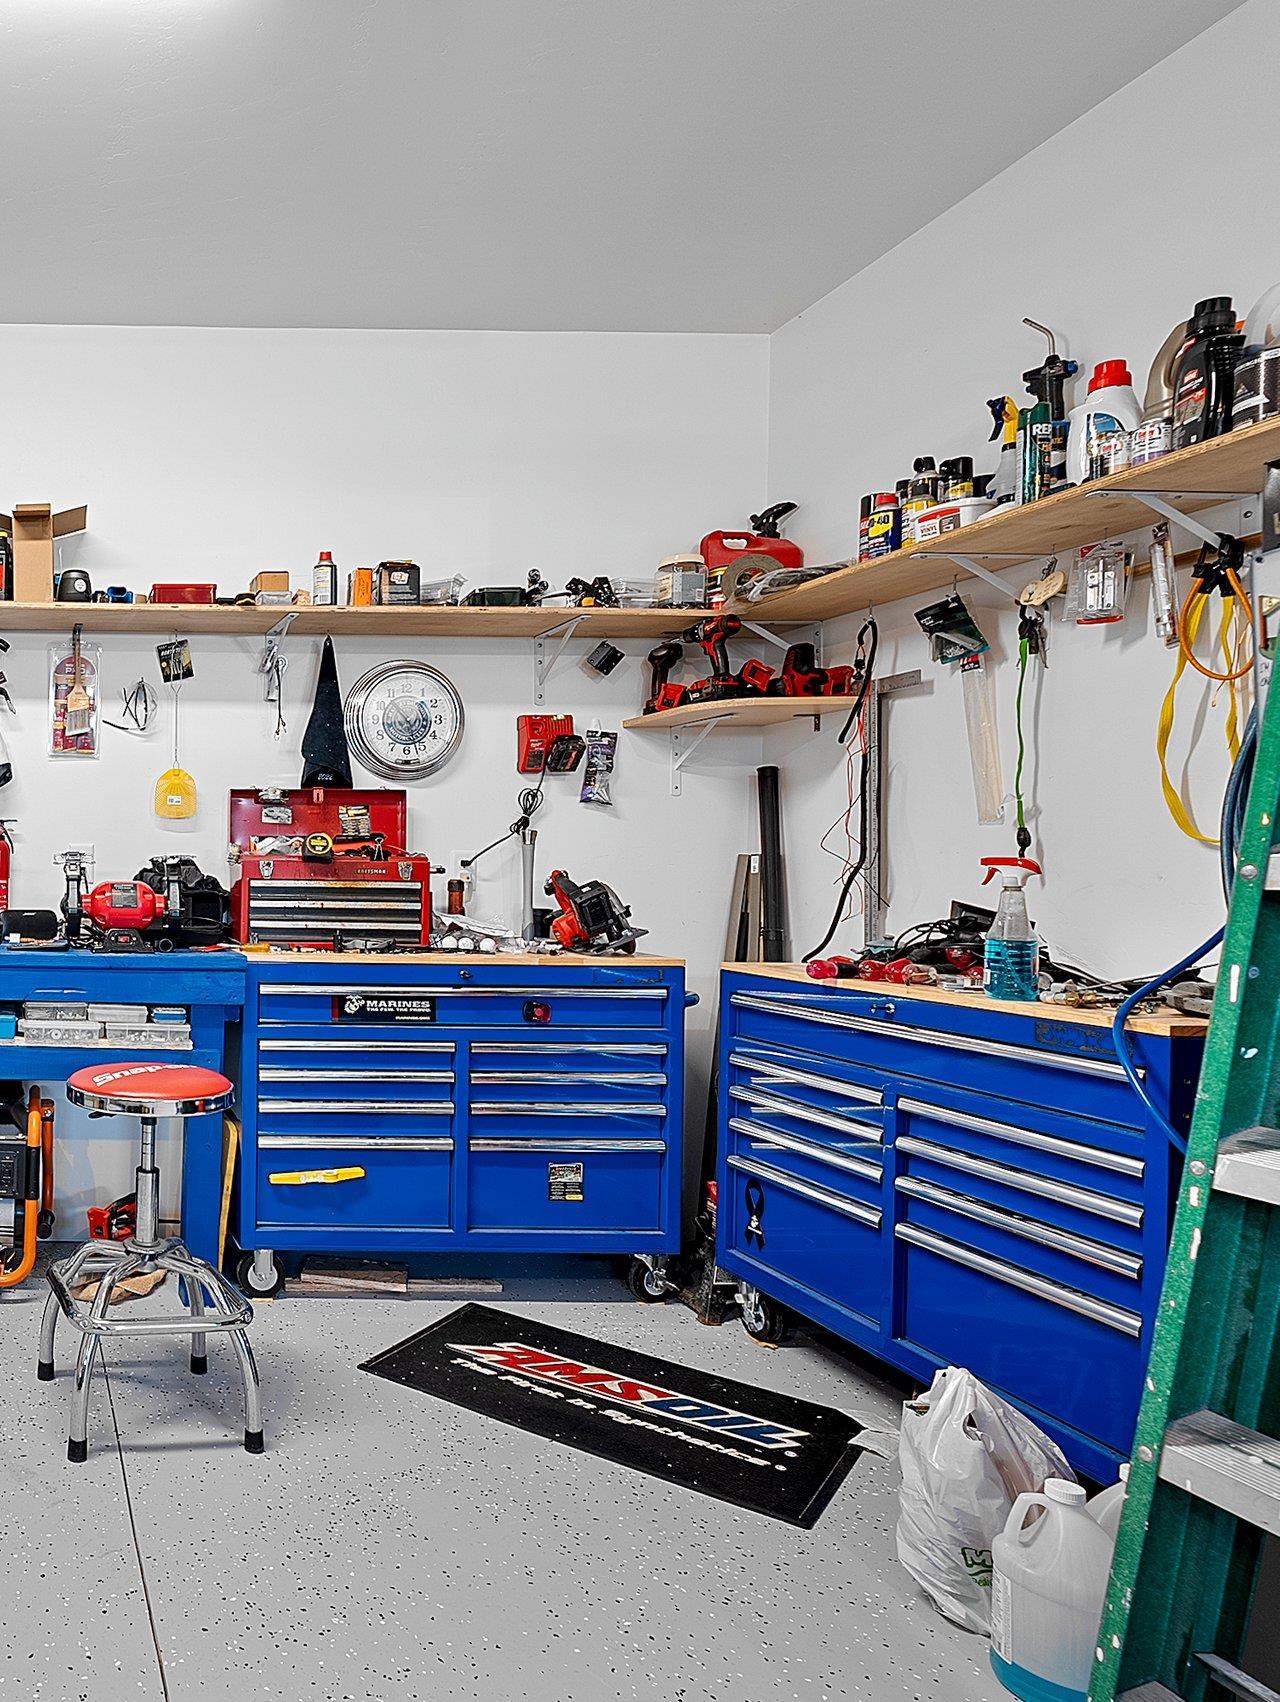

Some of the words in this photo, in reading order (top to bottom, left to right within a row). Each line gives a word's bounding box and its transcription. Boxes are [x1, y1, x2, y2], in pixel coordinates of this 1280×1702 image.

[387, 688, 396, 698] 11
[401, 683, 413, 694] 12
[420, 687, 426, 697] 1
[376, 700, 386, 712] 10
[430, 698, 439, 709] 2
[371, 713, 380, 725] 9
[434, 713, 443, 726] 3
[376, 729, 385, 741] 8
[429, 729, 438, 740] 4
[388, 741, 397, 752] 7
[402, 745, 411, 756] 6
[418, 741, 427, 752] 5
[366, 1000, 431, 1008] MARINES
[450, 1357, 497, 1376] The
[498, 1374, 565, 1400] First
[565, 1397, 597, 1411] in
[445, 1342, 811, 1449] AMSOIL
